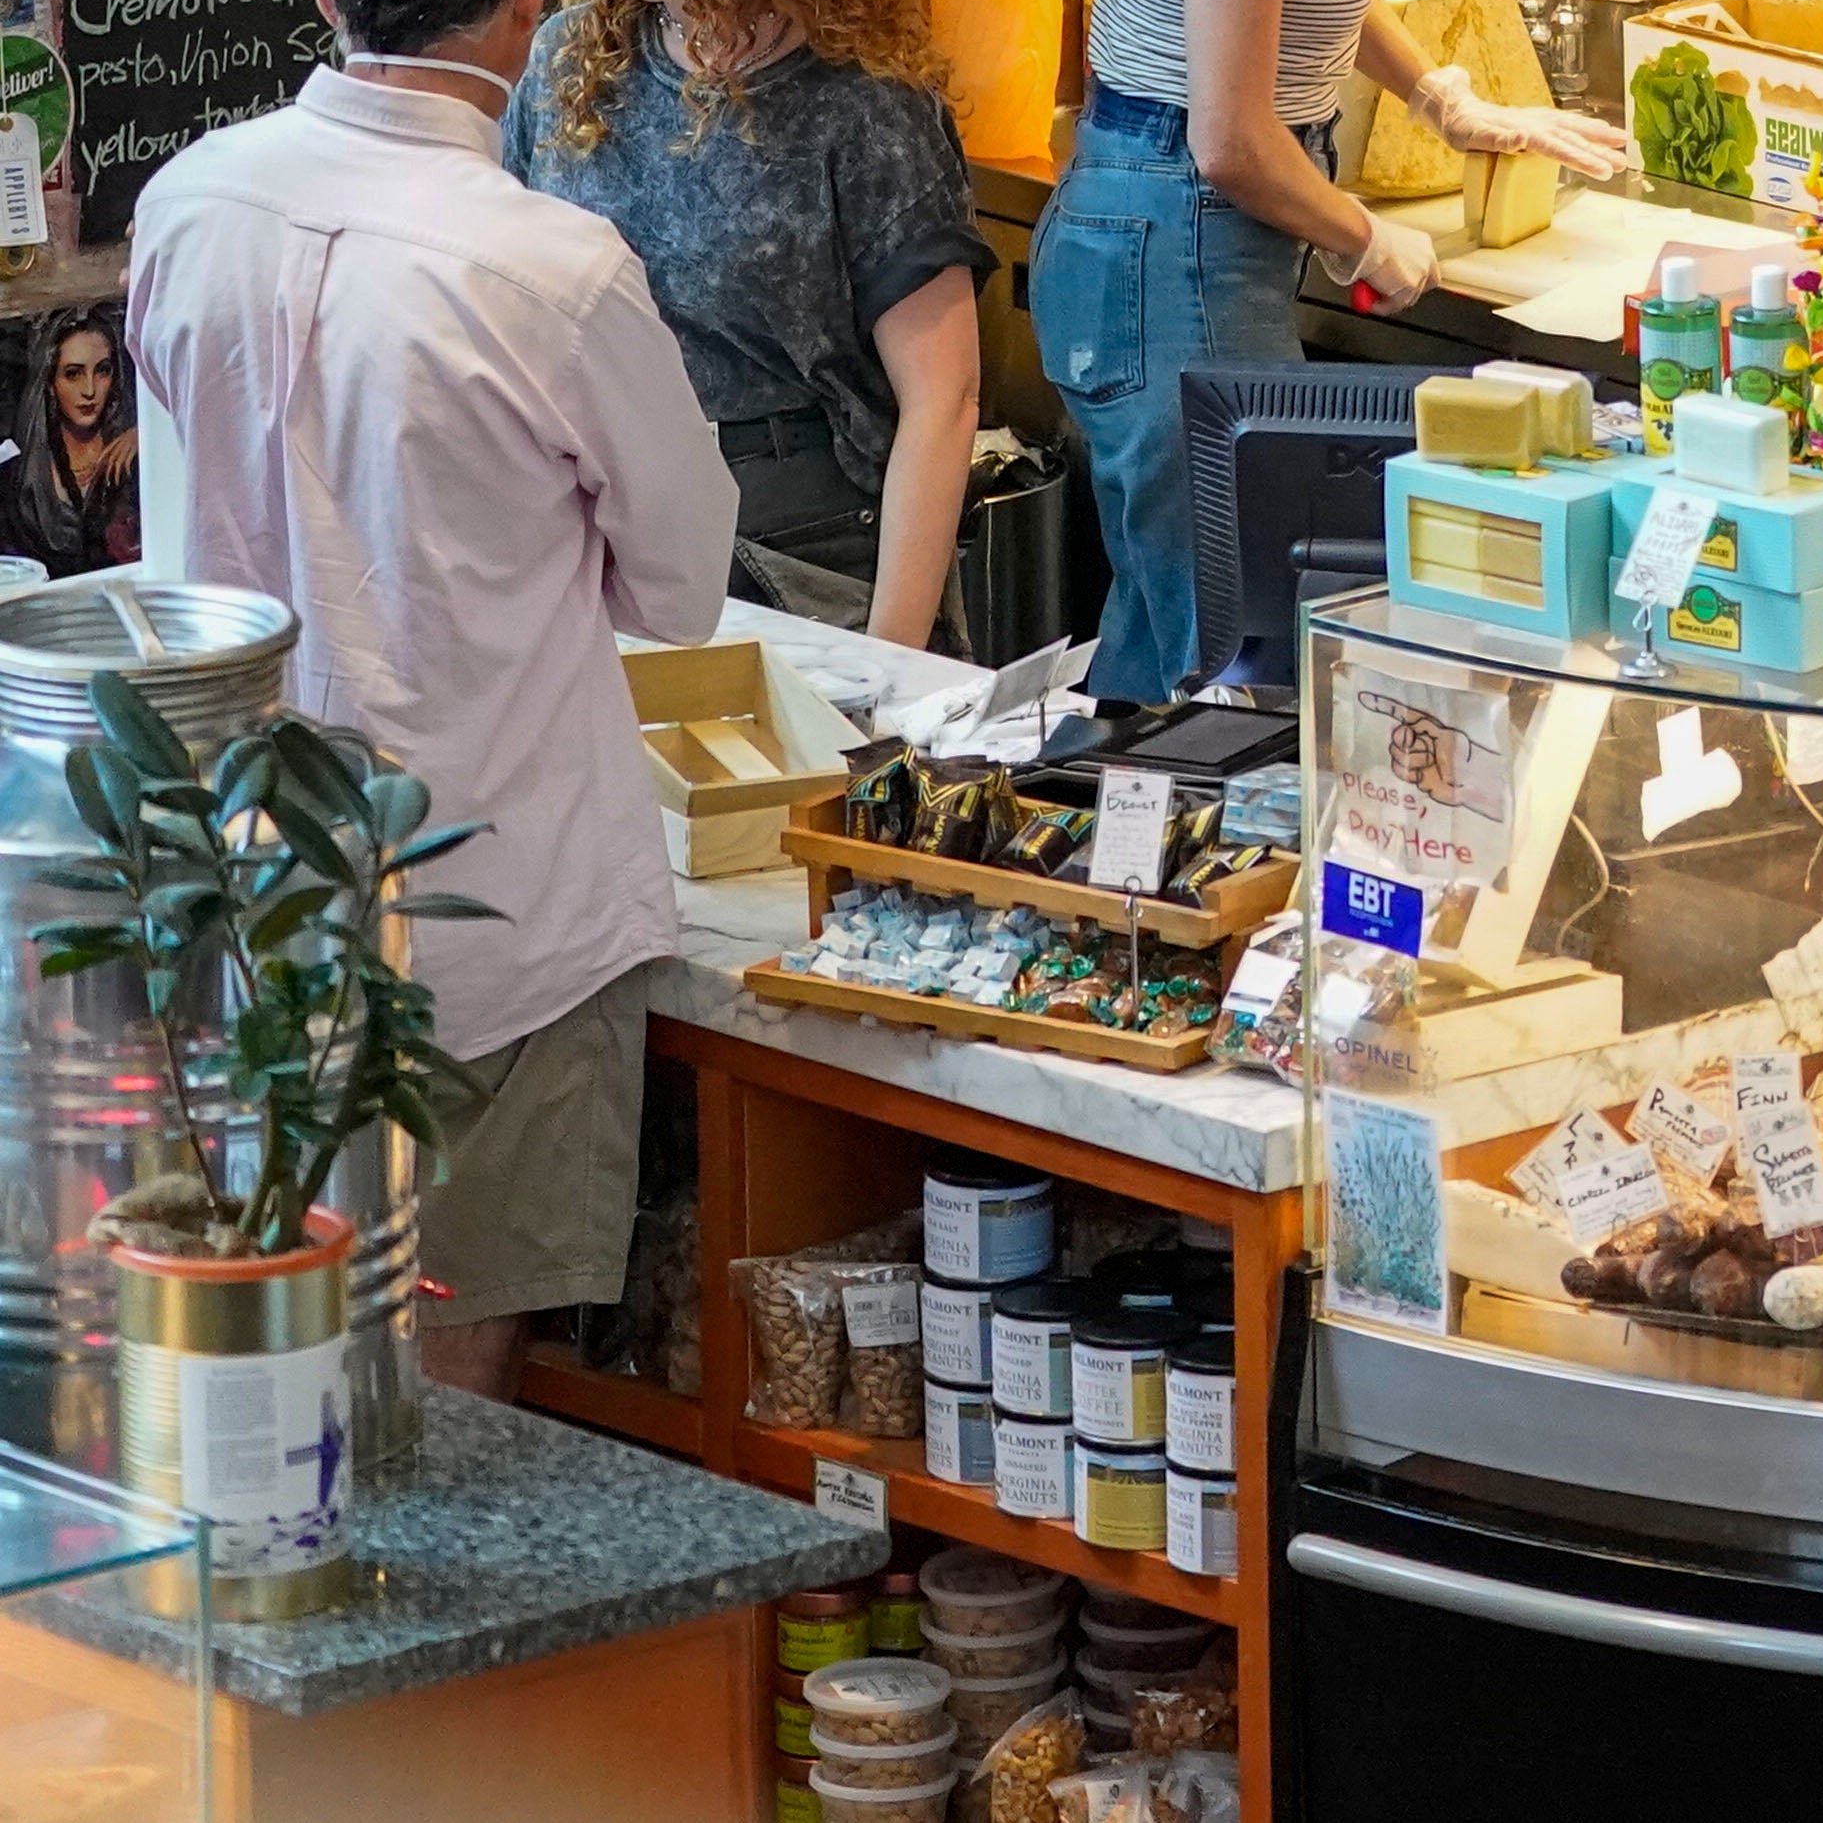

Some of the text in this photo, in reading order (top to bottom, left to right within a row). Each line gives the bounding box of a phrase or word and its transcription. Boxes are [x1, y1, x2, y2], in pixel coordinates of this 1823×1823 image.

[1, 56, 55, 99] eliver!
[78, 41, 177, 126] pesto,
[79, 118, 190, 197] yellow
[4, 166, 31, 236] APPLEBY'S
[1348, 810, 1474, 865] Pay Here
[1347, 872, 1396, 919] EBT
[1335, 1036, 1419, 1076] OPINEL
[1735, 1087, 1789, 1111] FINN
